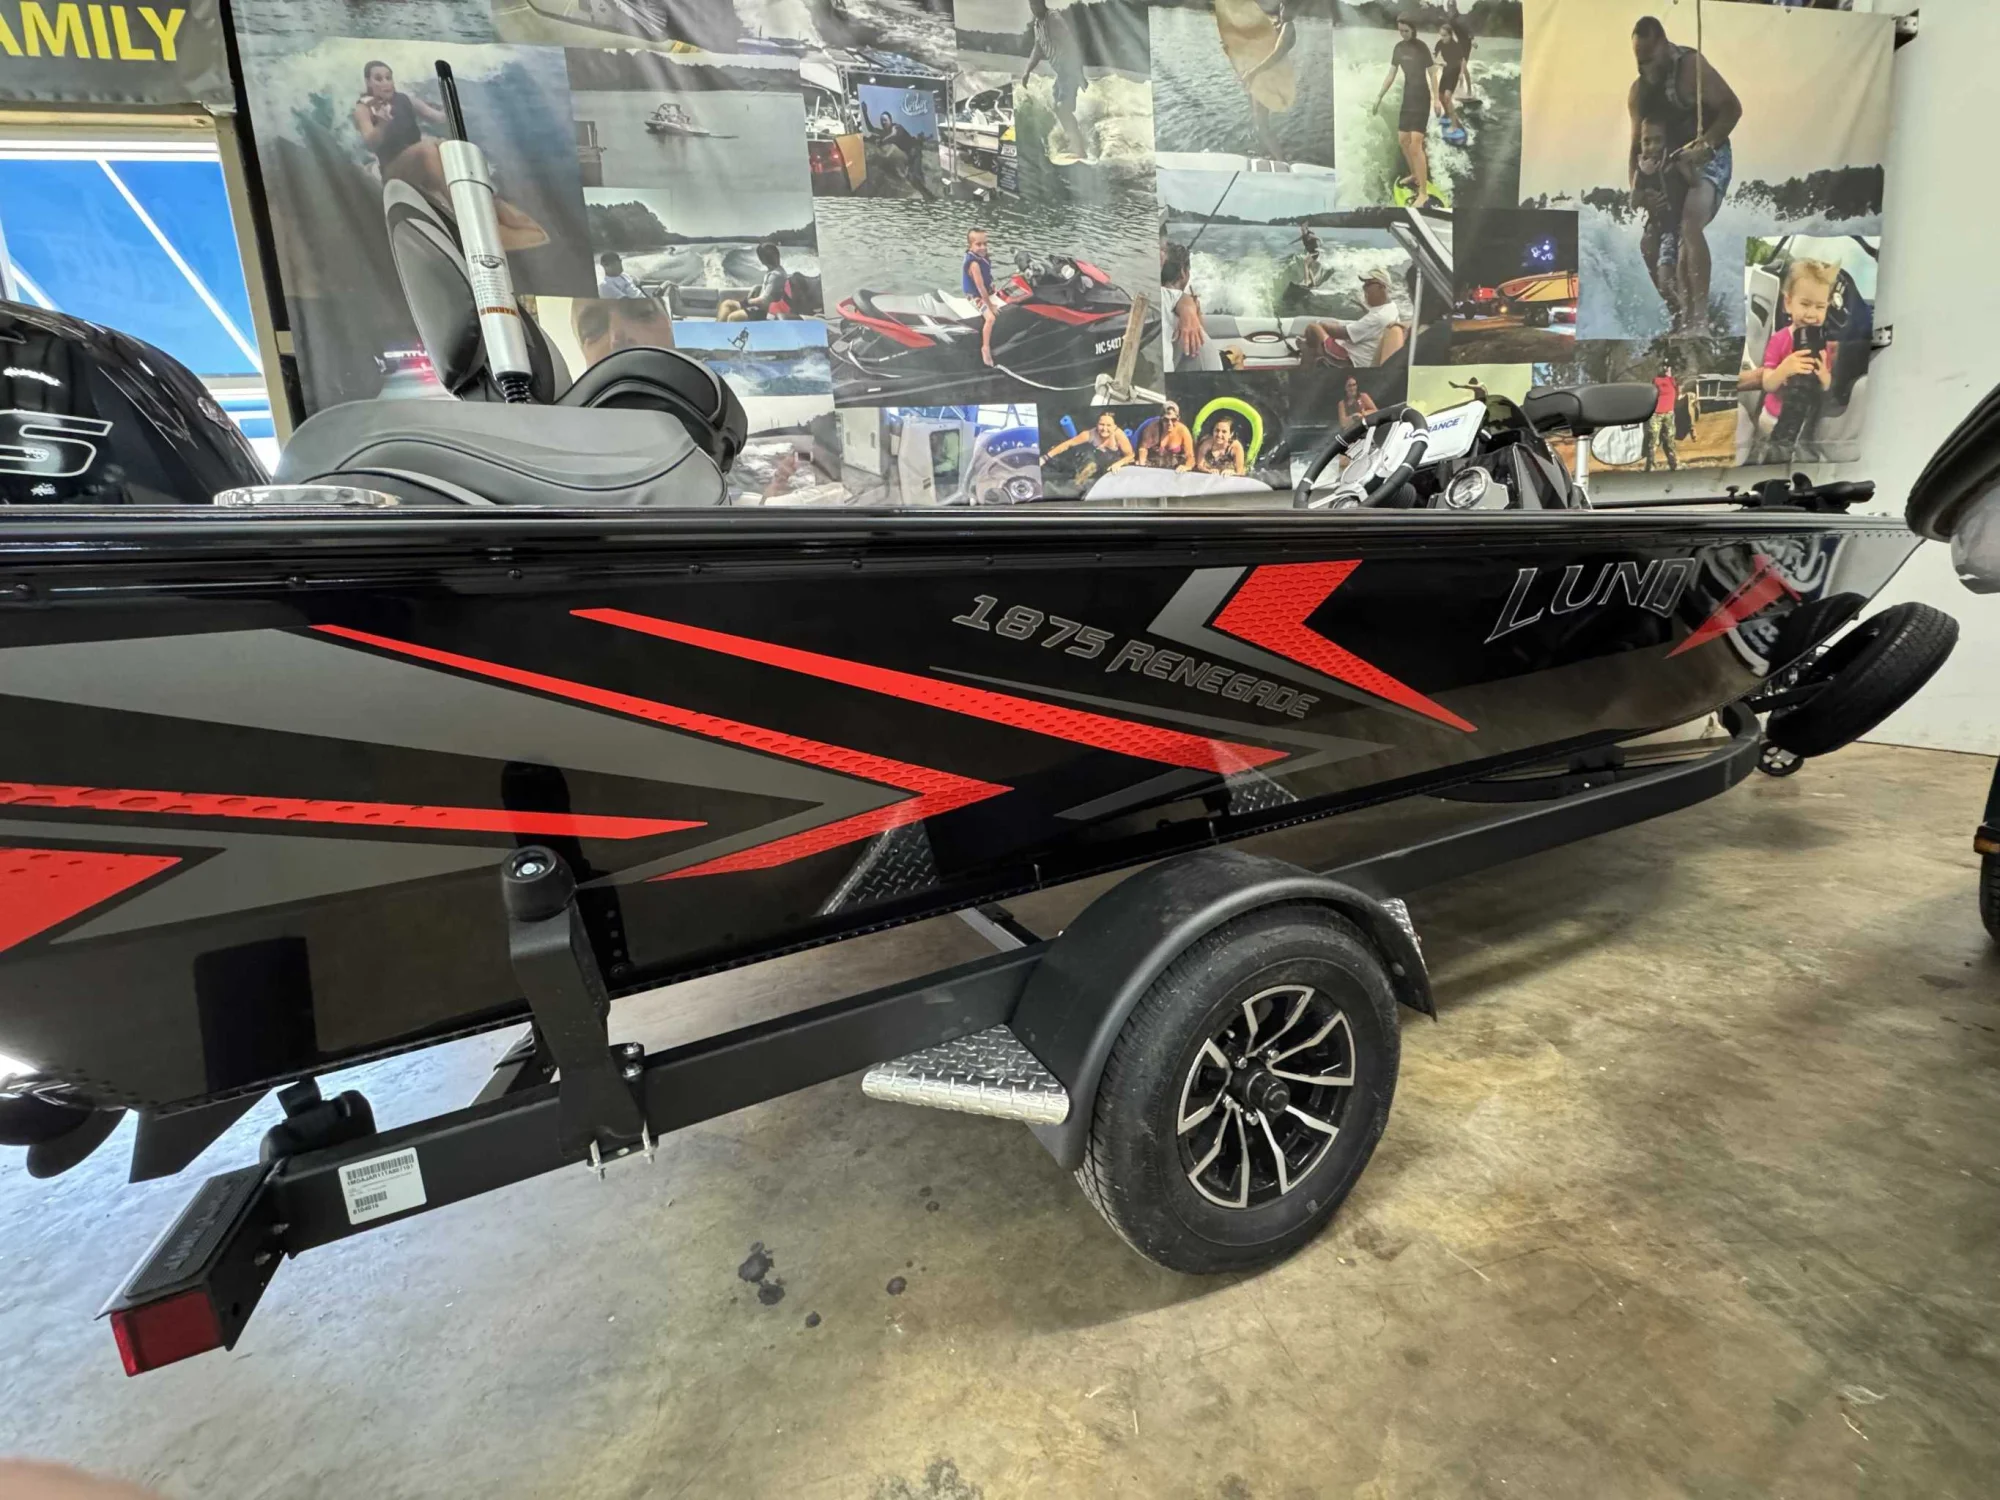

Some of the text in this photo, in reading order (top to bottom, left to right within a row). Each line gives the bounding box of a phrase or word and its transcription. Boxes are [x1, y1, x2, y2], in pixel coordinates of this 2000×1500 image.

[1403, 418, 1460, 440] LRANCE
[1484, 557, 1695, 644] LUND
[952, 594, 1320, 719] 1875 RENEGADE
